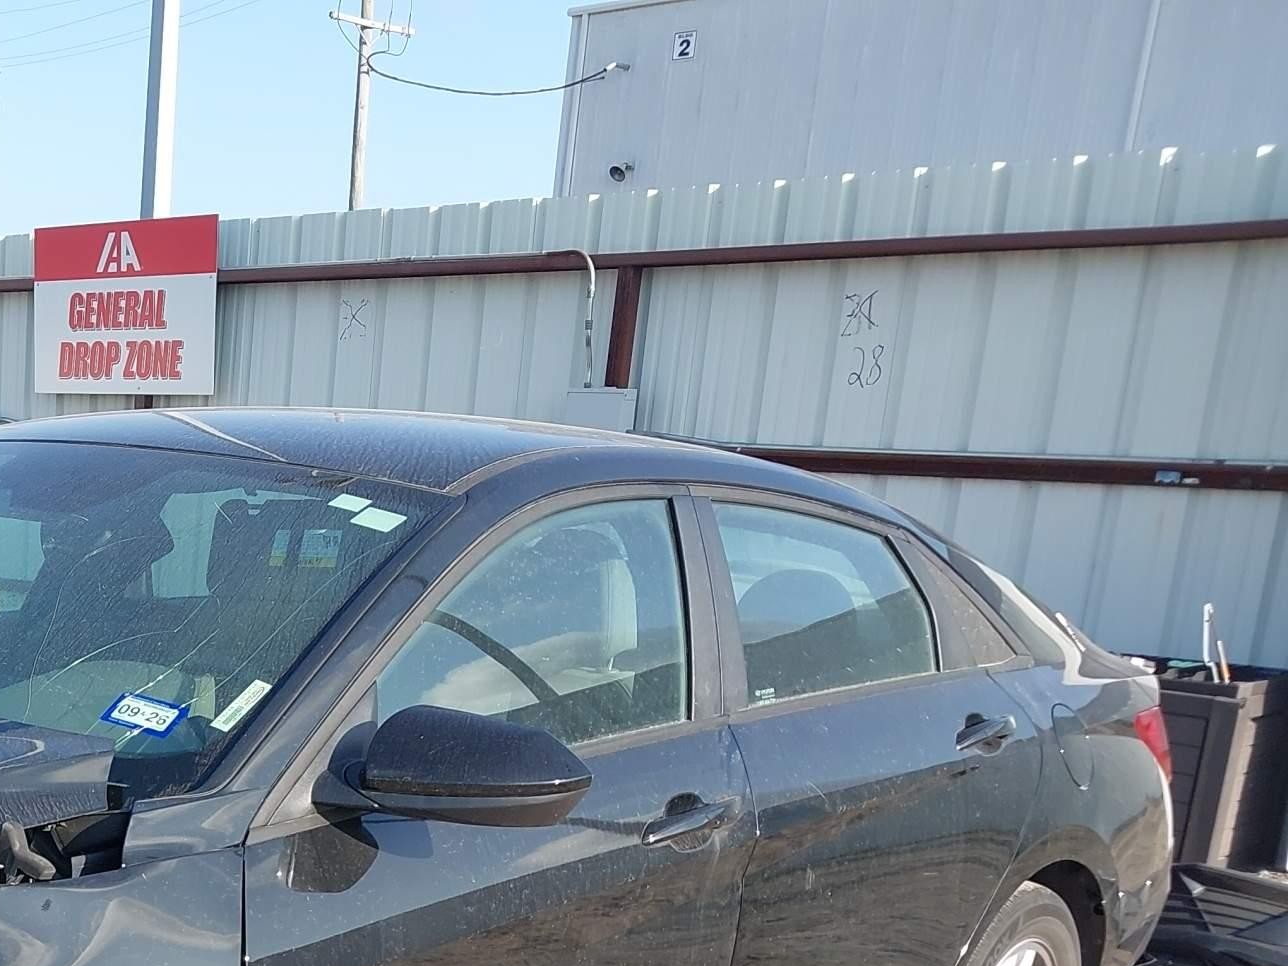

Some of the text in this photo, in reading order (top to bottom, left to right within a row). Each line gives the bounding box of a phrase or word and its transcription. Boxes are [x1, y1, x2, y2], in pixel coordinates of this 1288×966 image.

[678, 38, 691, 58] 2
[69, 289, 168, 332] GENERAL
[58, 339, 185, 381] DROP ZONE
[847, 344, 885, 389] 28
